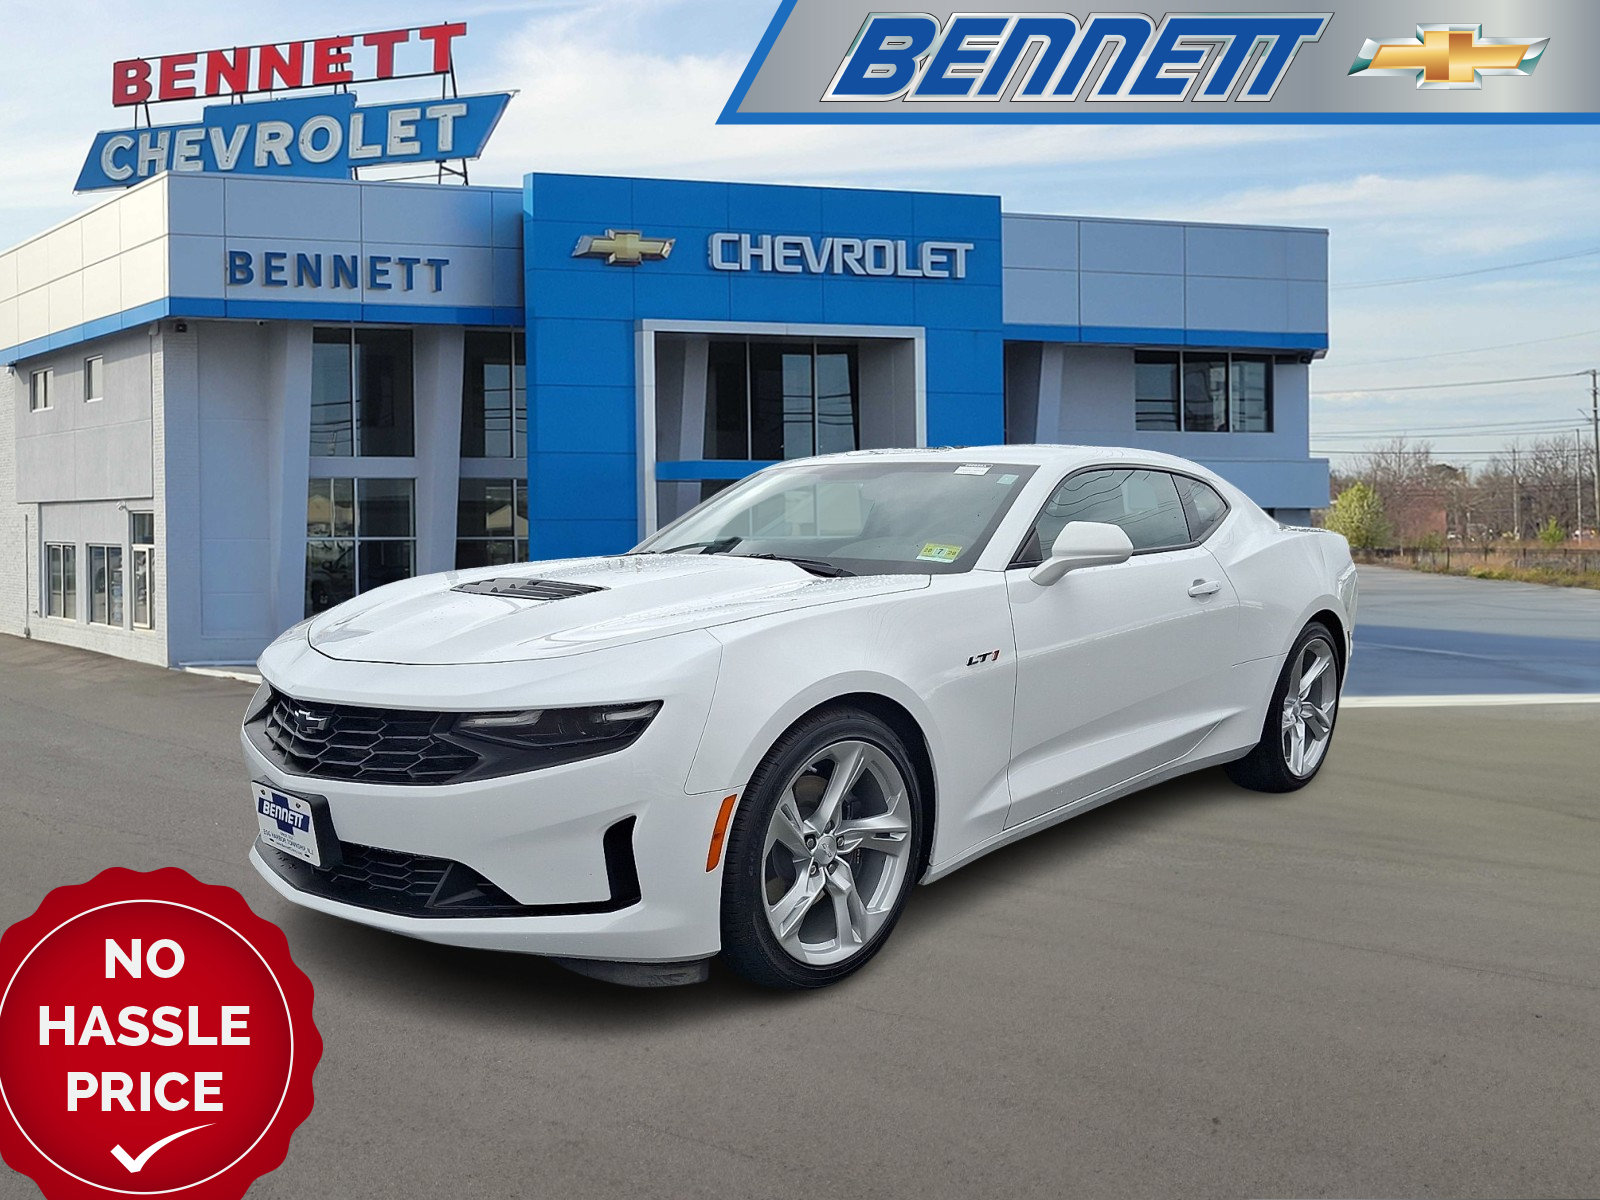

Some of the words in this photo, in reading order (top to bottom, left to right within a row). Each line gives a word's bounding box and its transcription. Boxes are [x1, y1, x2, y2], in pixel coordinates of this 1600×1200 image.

[112, 22, 467, 107] BENNETT
[101, 103, 468, 181] CHEVROLET
[227, 250, 450, 292] BENNETT
[708, 232, 975, 279] CHEVROLET
[966, 649, 1000, 666] LT1
[262, 801, 304, 828] BENNETT
